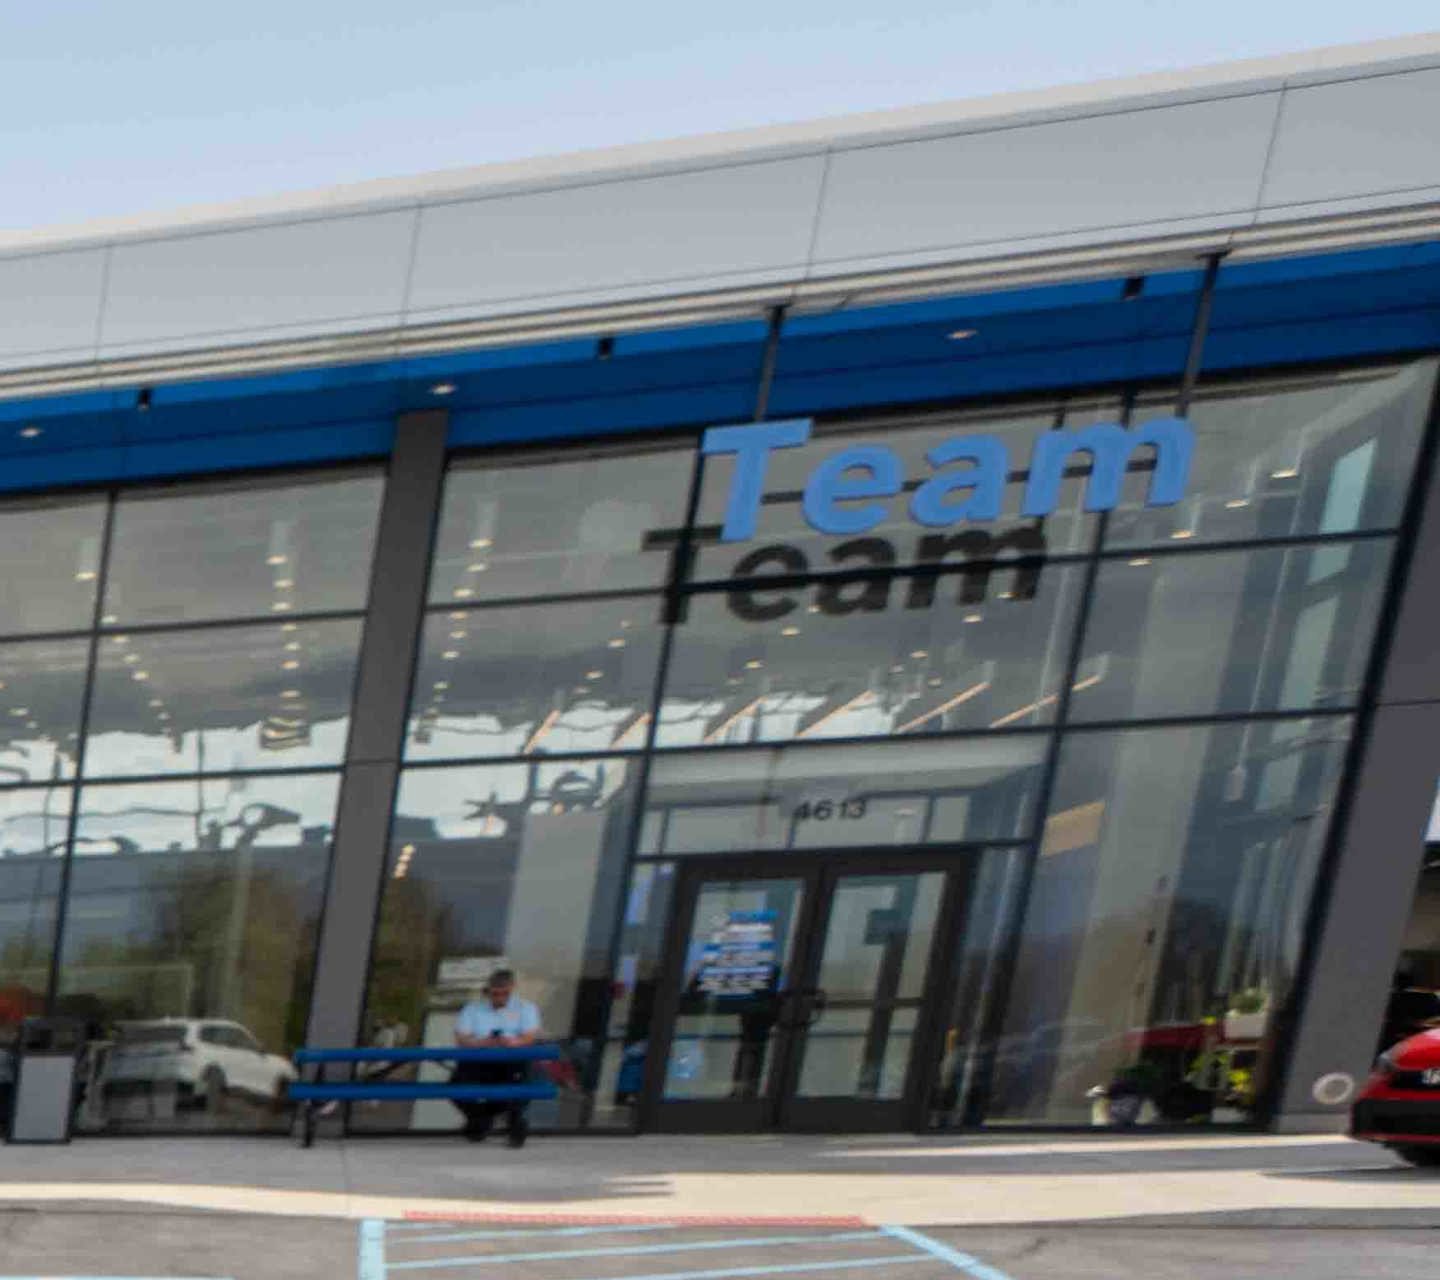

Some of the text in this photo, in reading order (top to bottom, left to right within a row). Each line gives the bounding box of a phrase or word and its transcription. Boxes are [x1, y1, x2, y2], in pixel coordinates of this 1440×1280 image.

[702, 415, 1197, 542] Team
[642, 519, 1047, 625] Team
[792, 798, 867, 821] 4613
